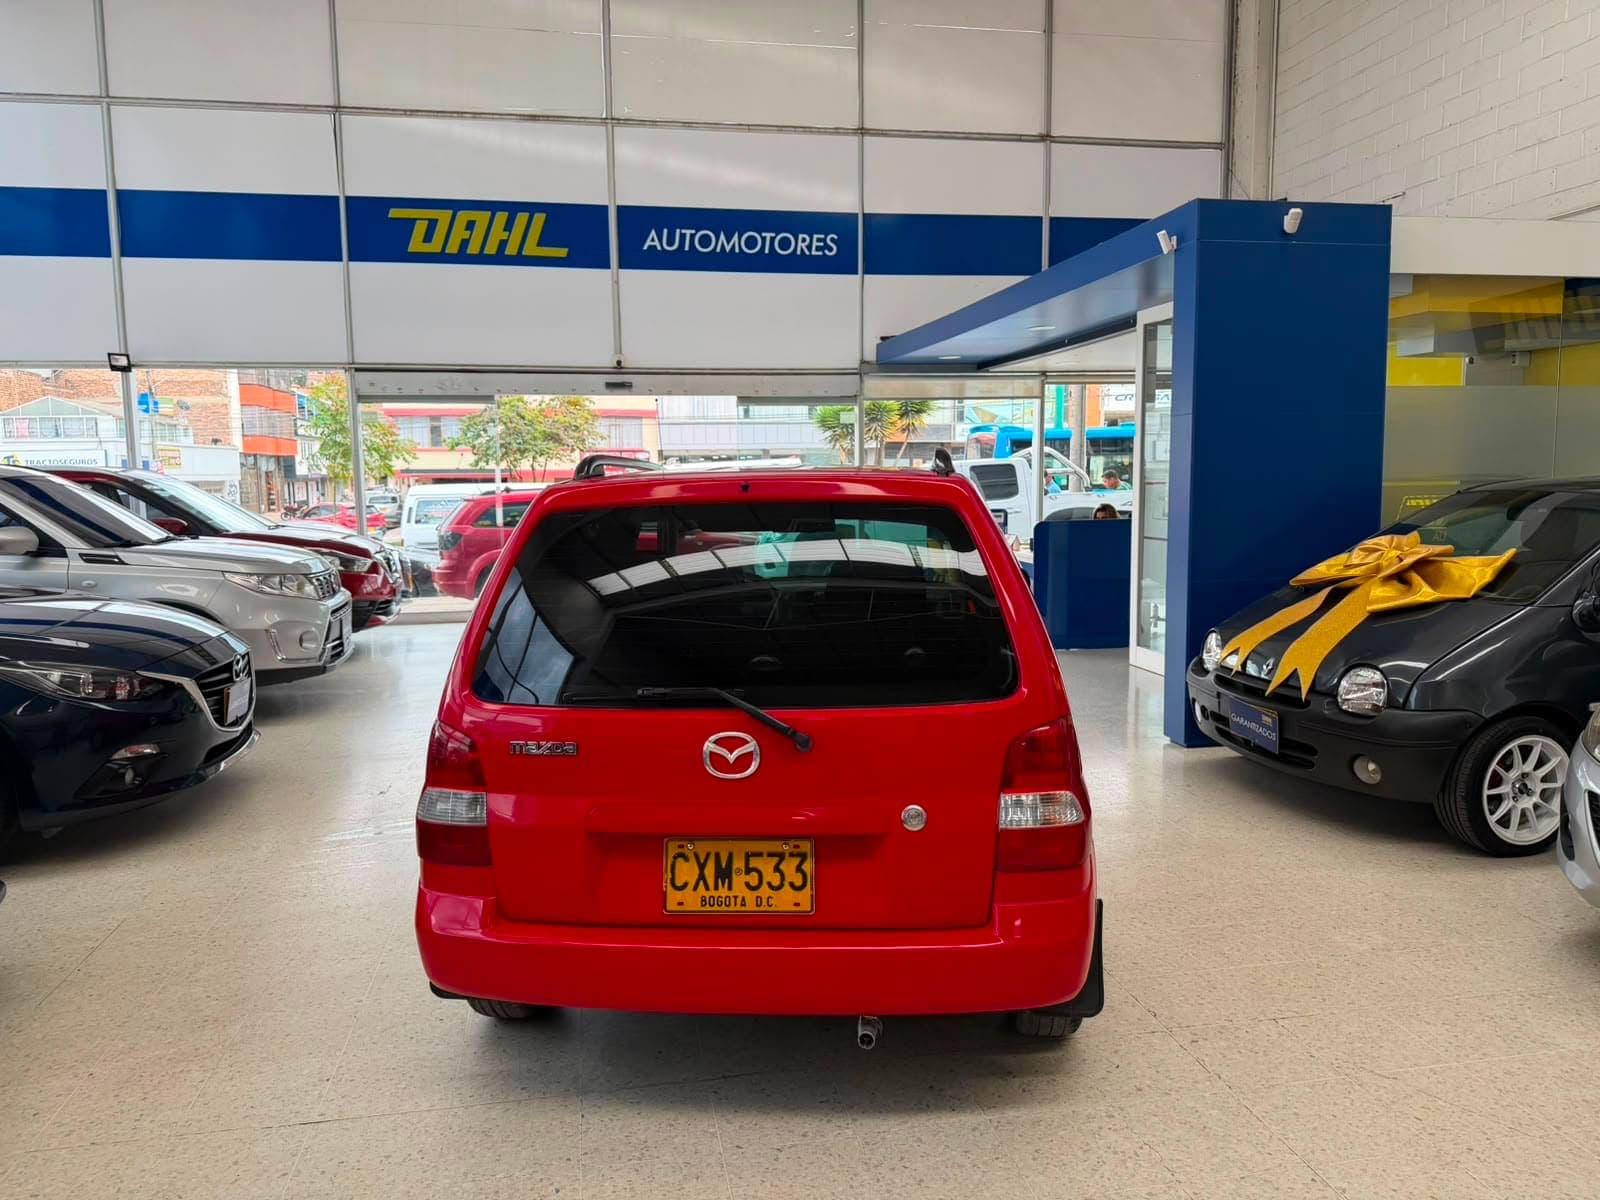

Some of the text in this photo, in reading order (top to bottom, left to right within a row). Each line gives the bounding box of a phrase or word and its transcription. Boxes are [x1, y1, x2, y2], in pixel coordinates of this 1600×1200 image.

[387, 207, 569, 258] DAHL
[642, 228, 838, 257] AUTOMOTORES
[1230, 712, 1277, 741] GARANTIZADOS
[669, 850, 810, 893] CXM 533
[699, 895, 748, 909] BOGOTA
